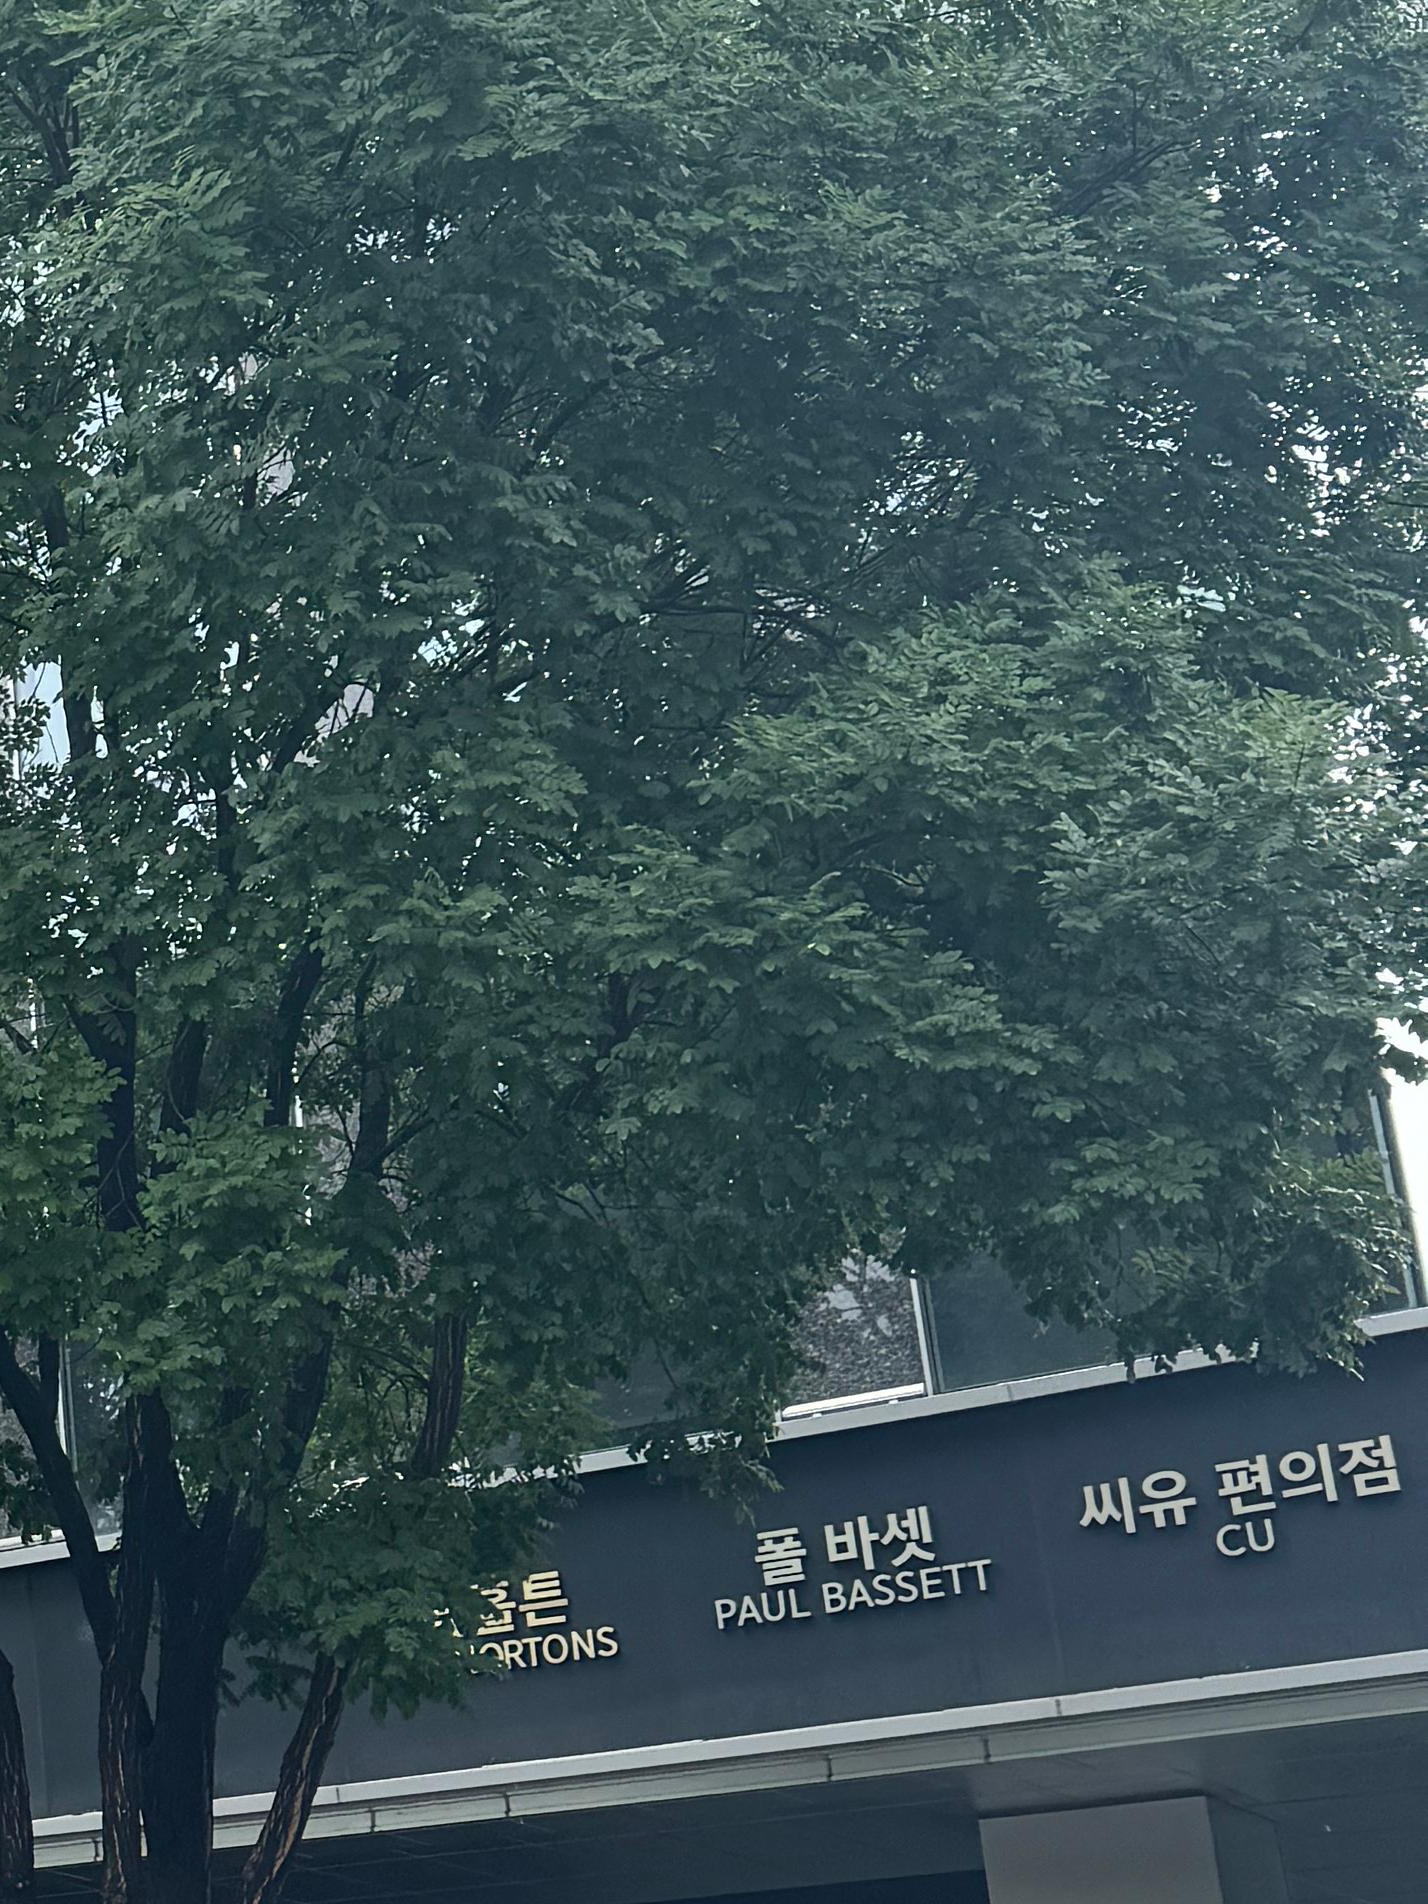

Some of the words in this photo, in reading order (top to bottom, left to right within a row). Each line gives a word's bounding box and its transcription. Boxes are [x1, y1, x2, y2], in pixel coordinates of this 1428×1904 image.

[1078, 1467, 1197, 1537] 씨유
[1215, 1433, 1403, 1515] 편의점
[753, 1528, 809, 1587] 폴
[824, 1505, 934, 1573] 바셋
[1215, 1517, 1276, 1558] CU
[714, 1585, 812, 1630] PAUL
[821, 1557, 993, 1615] BASSETT
